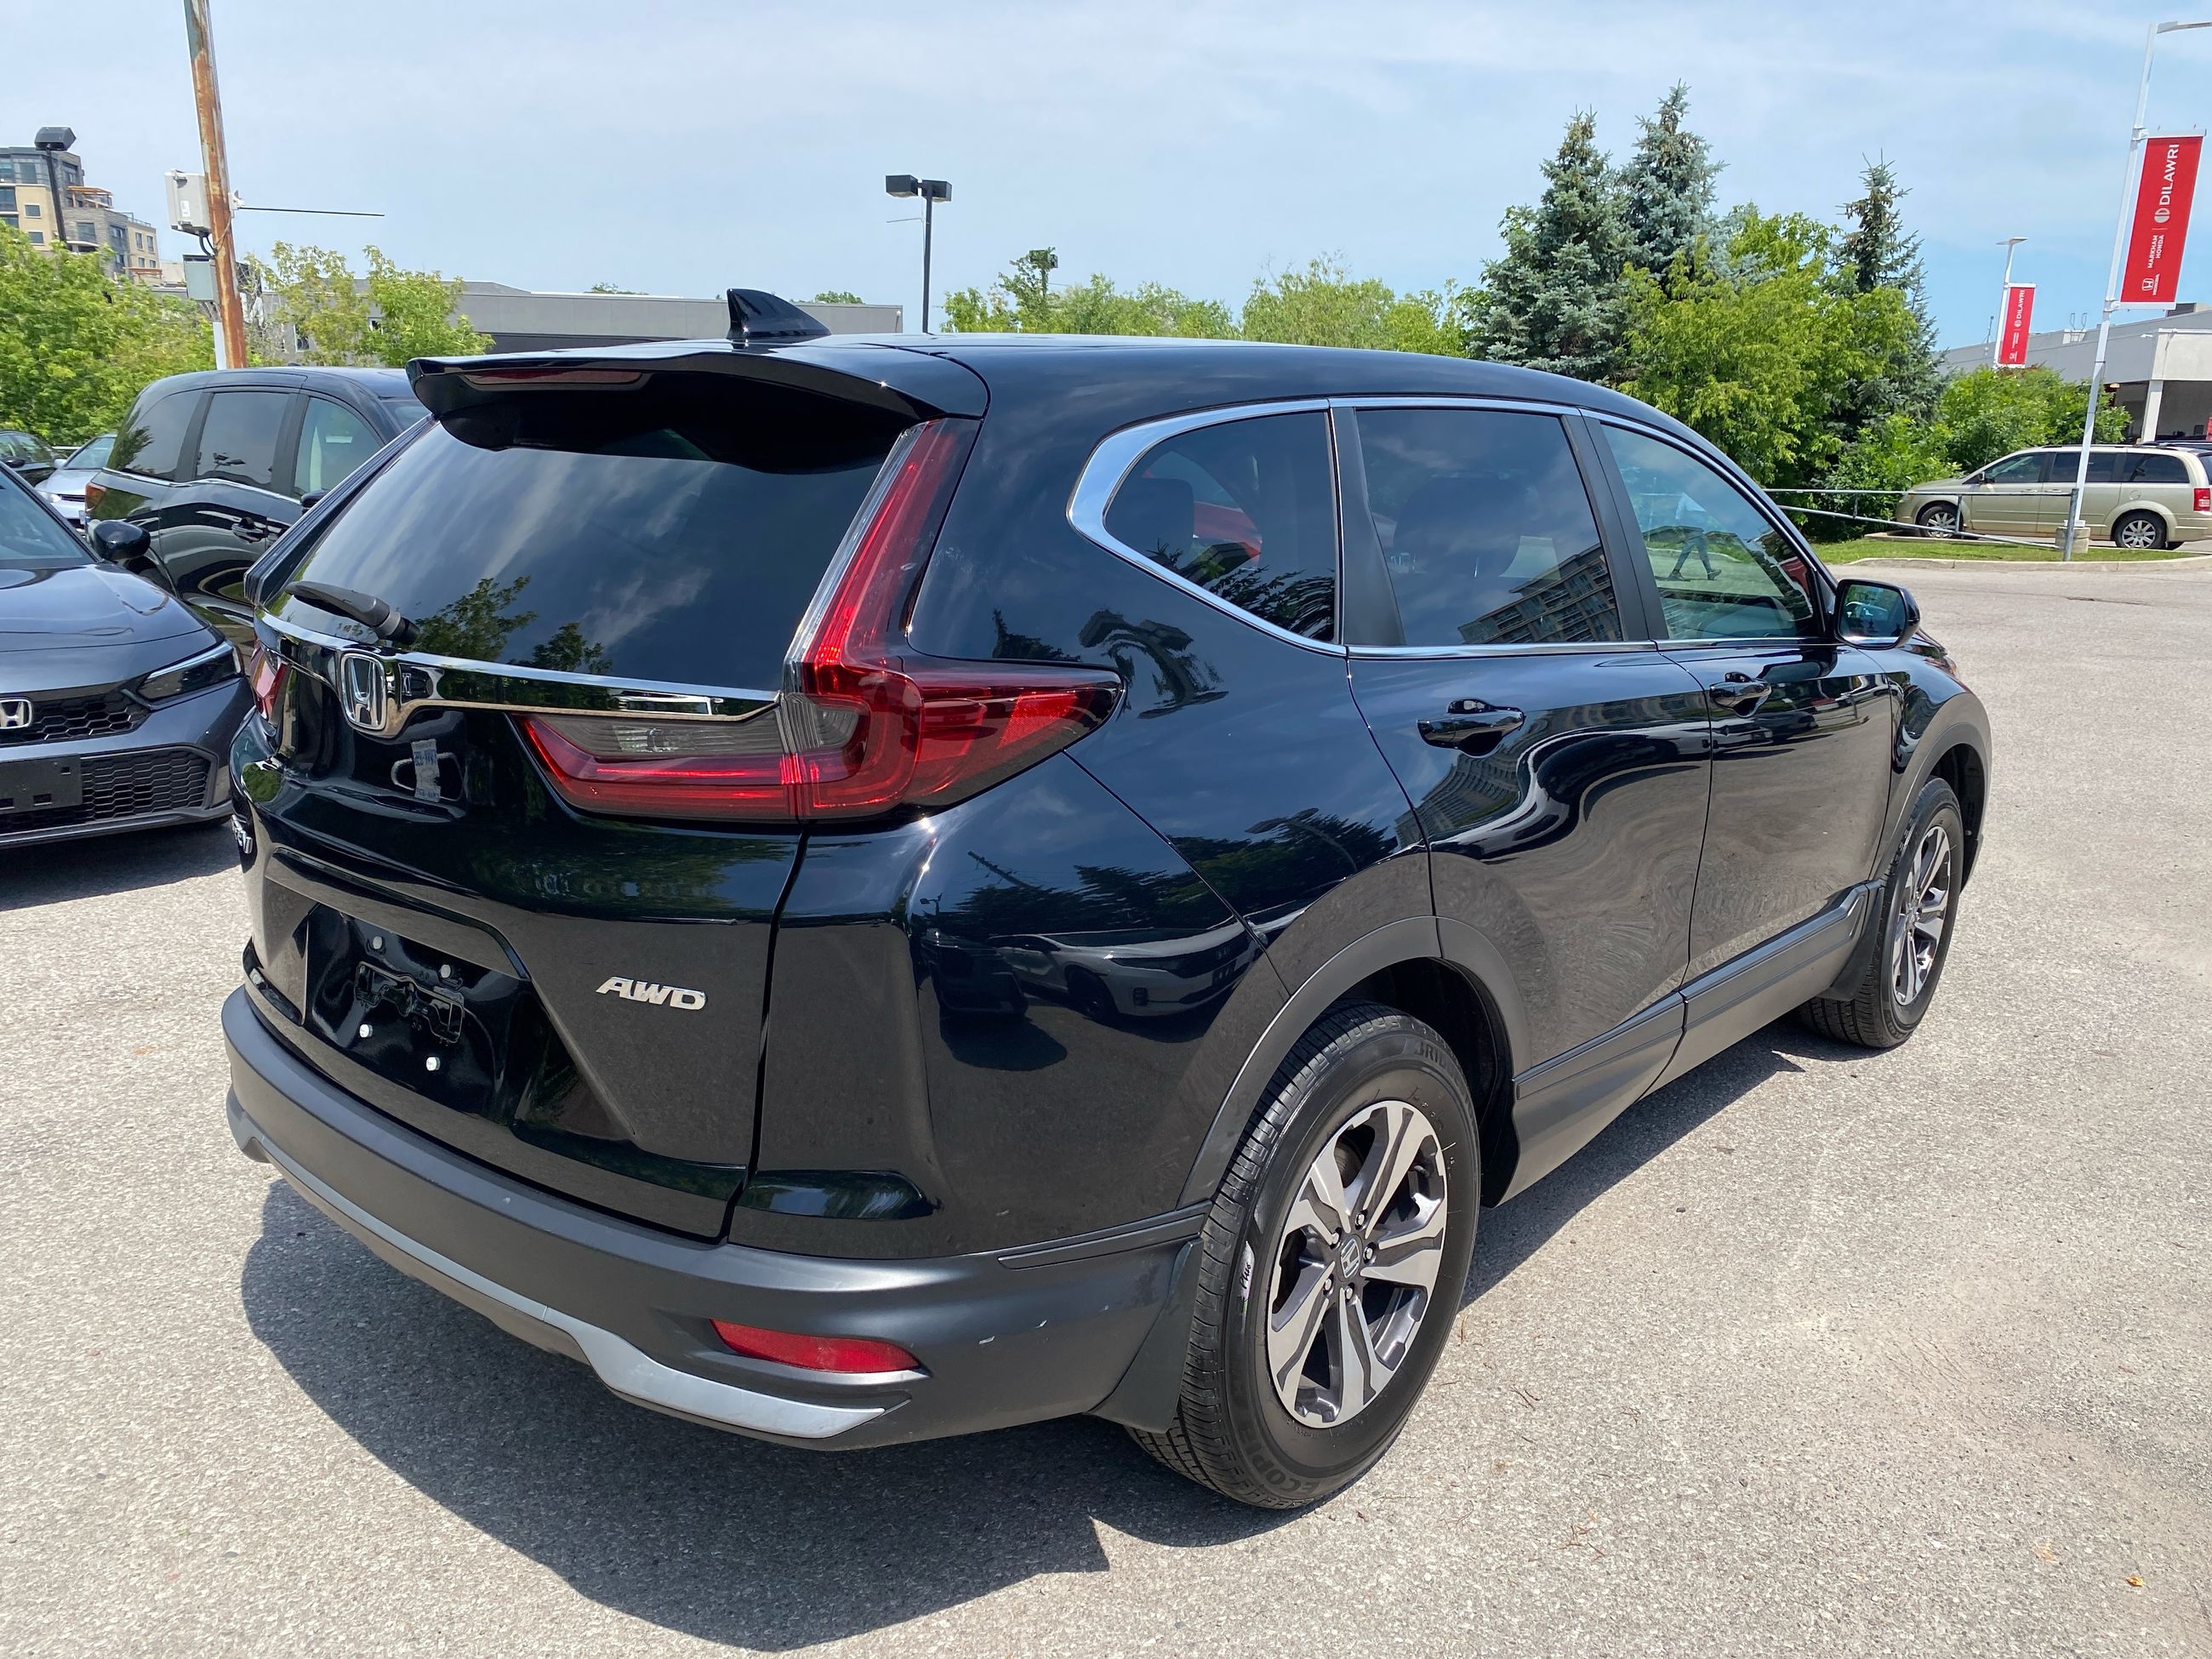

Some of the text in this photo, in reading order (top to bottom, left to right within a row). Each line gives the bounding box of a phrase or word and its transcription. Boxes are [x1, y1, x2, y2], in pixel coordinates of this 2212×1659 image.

[2158, 144, 2180, 206] DILAWRI
[2147, 235, 2158, 269] MARKHAM
[2155, 234, 2165, 259] HONDA
[2016, 289, 2026, 319] DILAWRI
[596, 976, 708, 1011] AWD
